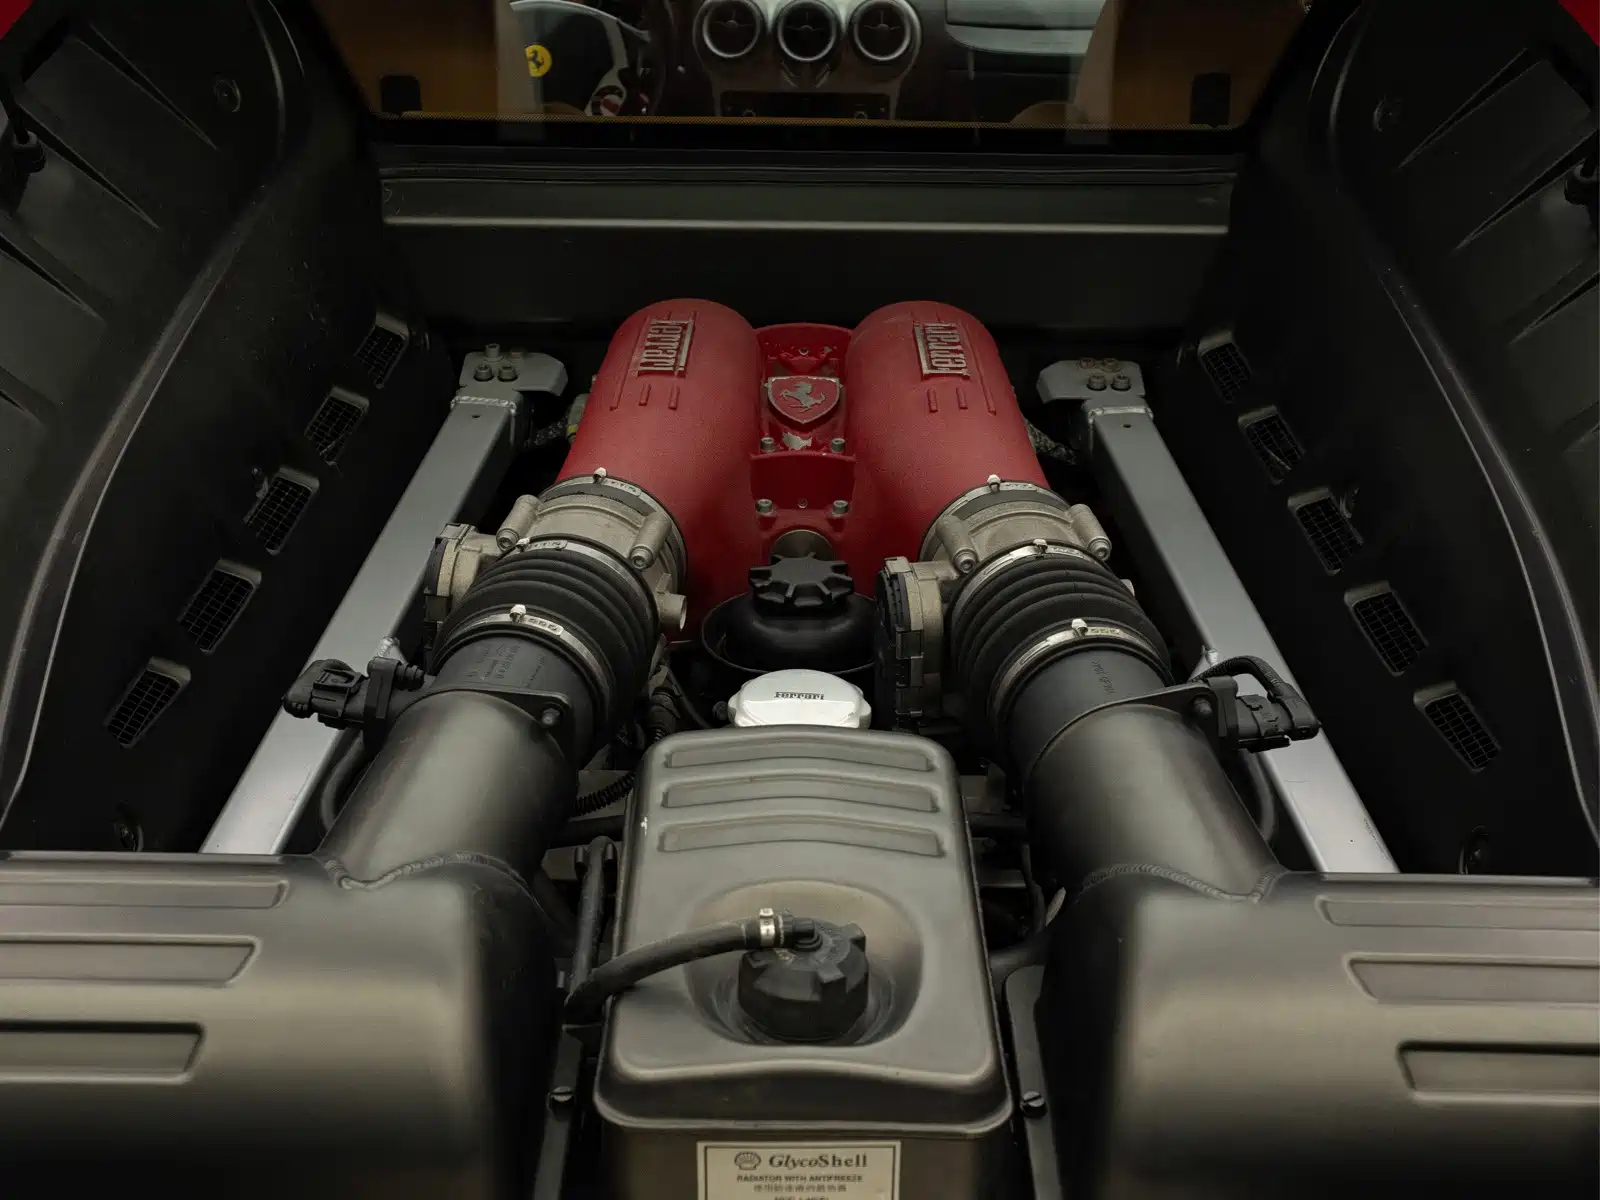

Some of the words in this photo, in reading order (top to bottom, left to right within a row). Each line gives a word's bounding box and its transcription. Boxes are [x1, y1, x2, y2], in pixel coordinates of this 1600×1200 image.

[638, 319, 693, 371] Ferrari
[912, 322, 970, 376] Ferrari
[774, 691, 825, 700] Ferrari
[769, 1153, 868, 1170] GlycoShell
[784, 1174, 807, 1182] WITH
